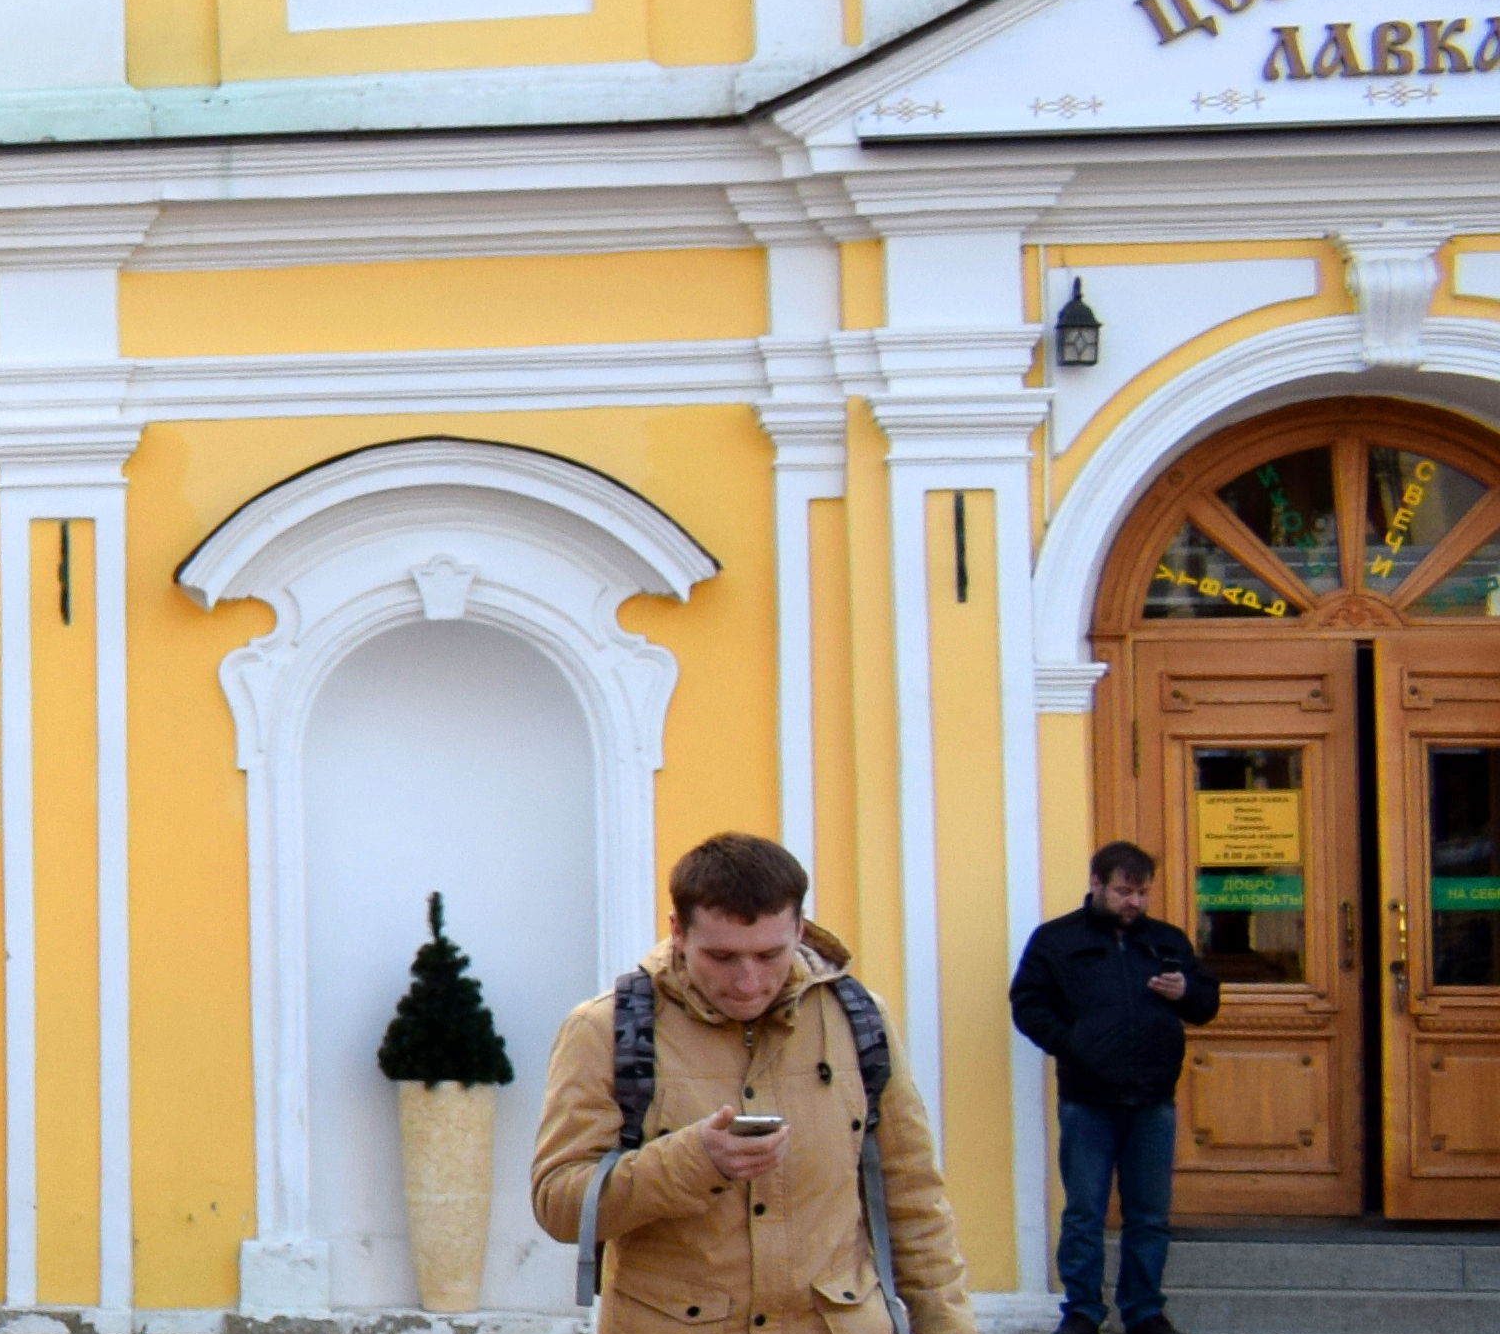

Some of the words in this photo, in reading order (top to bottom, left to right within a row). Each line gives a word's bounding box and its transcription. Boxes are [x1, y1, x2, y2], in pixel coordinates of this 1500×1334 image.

[1371, 460, 1436, 578] СВЕЧИ
[1155, 564, 1287, 617] УТВАРЬ
[1223, 879, 1275, 892] ДОБРО
[1448, 889, 1466, 899] НА
